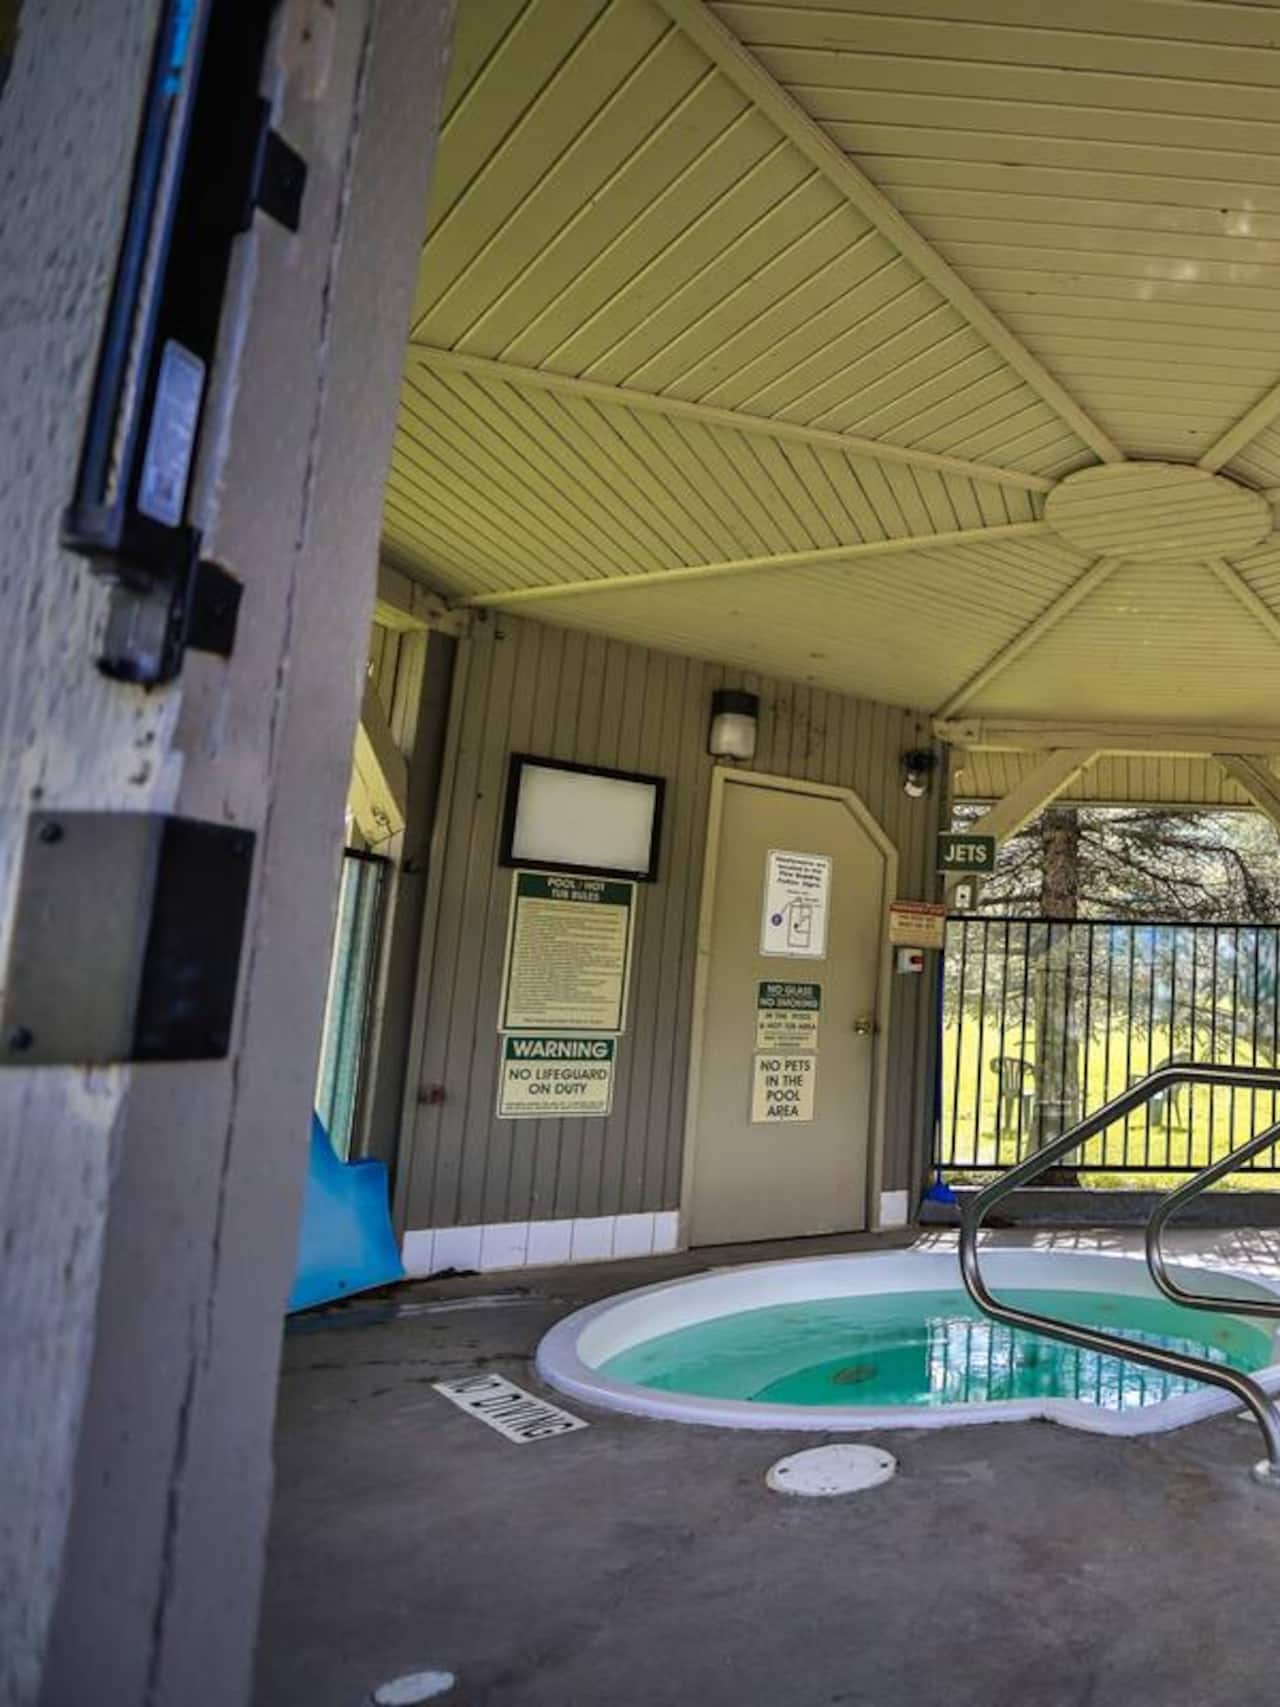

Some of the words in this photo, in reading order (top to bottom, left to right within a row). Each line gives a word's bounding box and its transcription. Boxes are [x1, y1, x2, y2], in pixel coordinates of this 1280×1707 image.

[943, 843, 987, 863] JETS
[547, 876, 576, 889] POOL
[584, 882, 605, 892] HOT
[552, 888, 569, 899] TUB
[571, 890, 600, 901] RULES
[766, 984, 784, 994] NO
[760, 998, 775, 1008] NO
[777, 998, 818, 1009] SMOKING
[512, 1040, 608, 1058] WARNING
[761, 1060, 781, 1071] NO
[784, 1060, 810, 1071] PETS
[509, 1068, 531, 1080] NO
[535, 1068, 607, 1080] LIFEGUARD
[766, 1075, 778, 1086] IN
[783, 1074, 803, 1087] THE
[529, 1082, 550, 1095] ON
[555, 1083, 587, 1095] DUTY
[767, 1089, 800, 1102] POOL
[767, 1104, 799, 1117] AREA
[440, 1374, 501, 1394] NO
[469, 1393, 574, 1438] DIVING
